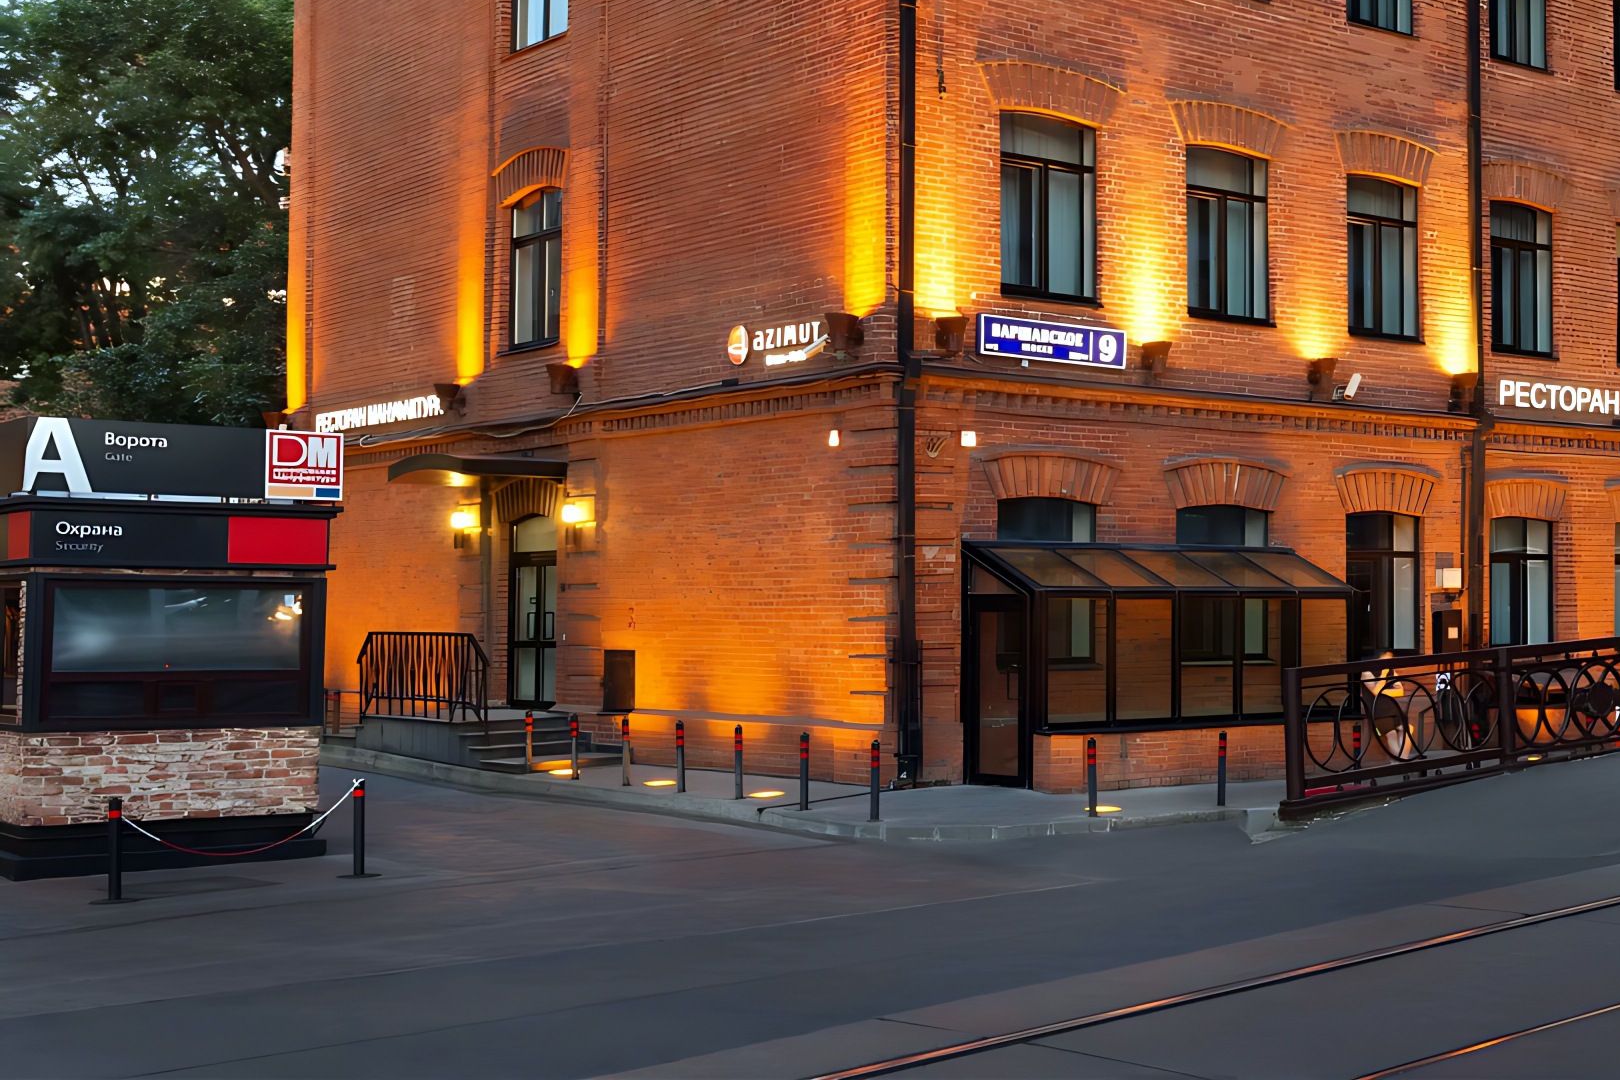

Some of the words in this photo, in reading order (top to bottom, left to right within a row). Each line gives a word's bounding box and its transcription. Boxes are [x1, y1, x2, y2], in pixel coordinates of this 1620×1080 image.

[1098, 334, 1117, 363] 9
[1499, 379, 1620, 416] РЕСТОРАН
[104, 431, 168, 449] Ворота
[272, 435, 337, 469] DM
[55, 521, 123, 538] Охрана
